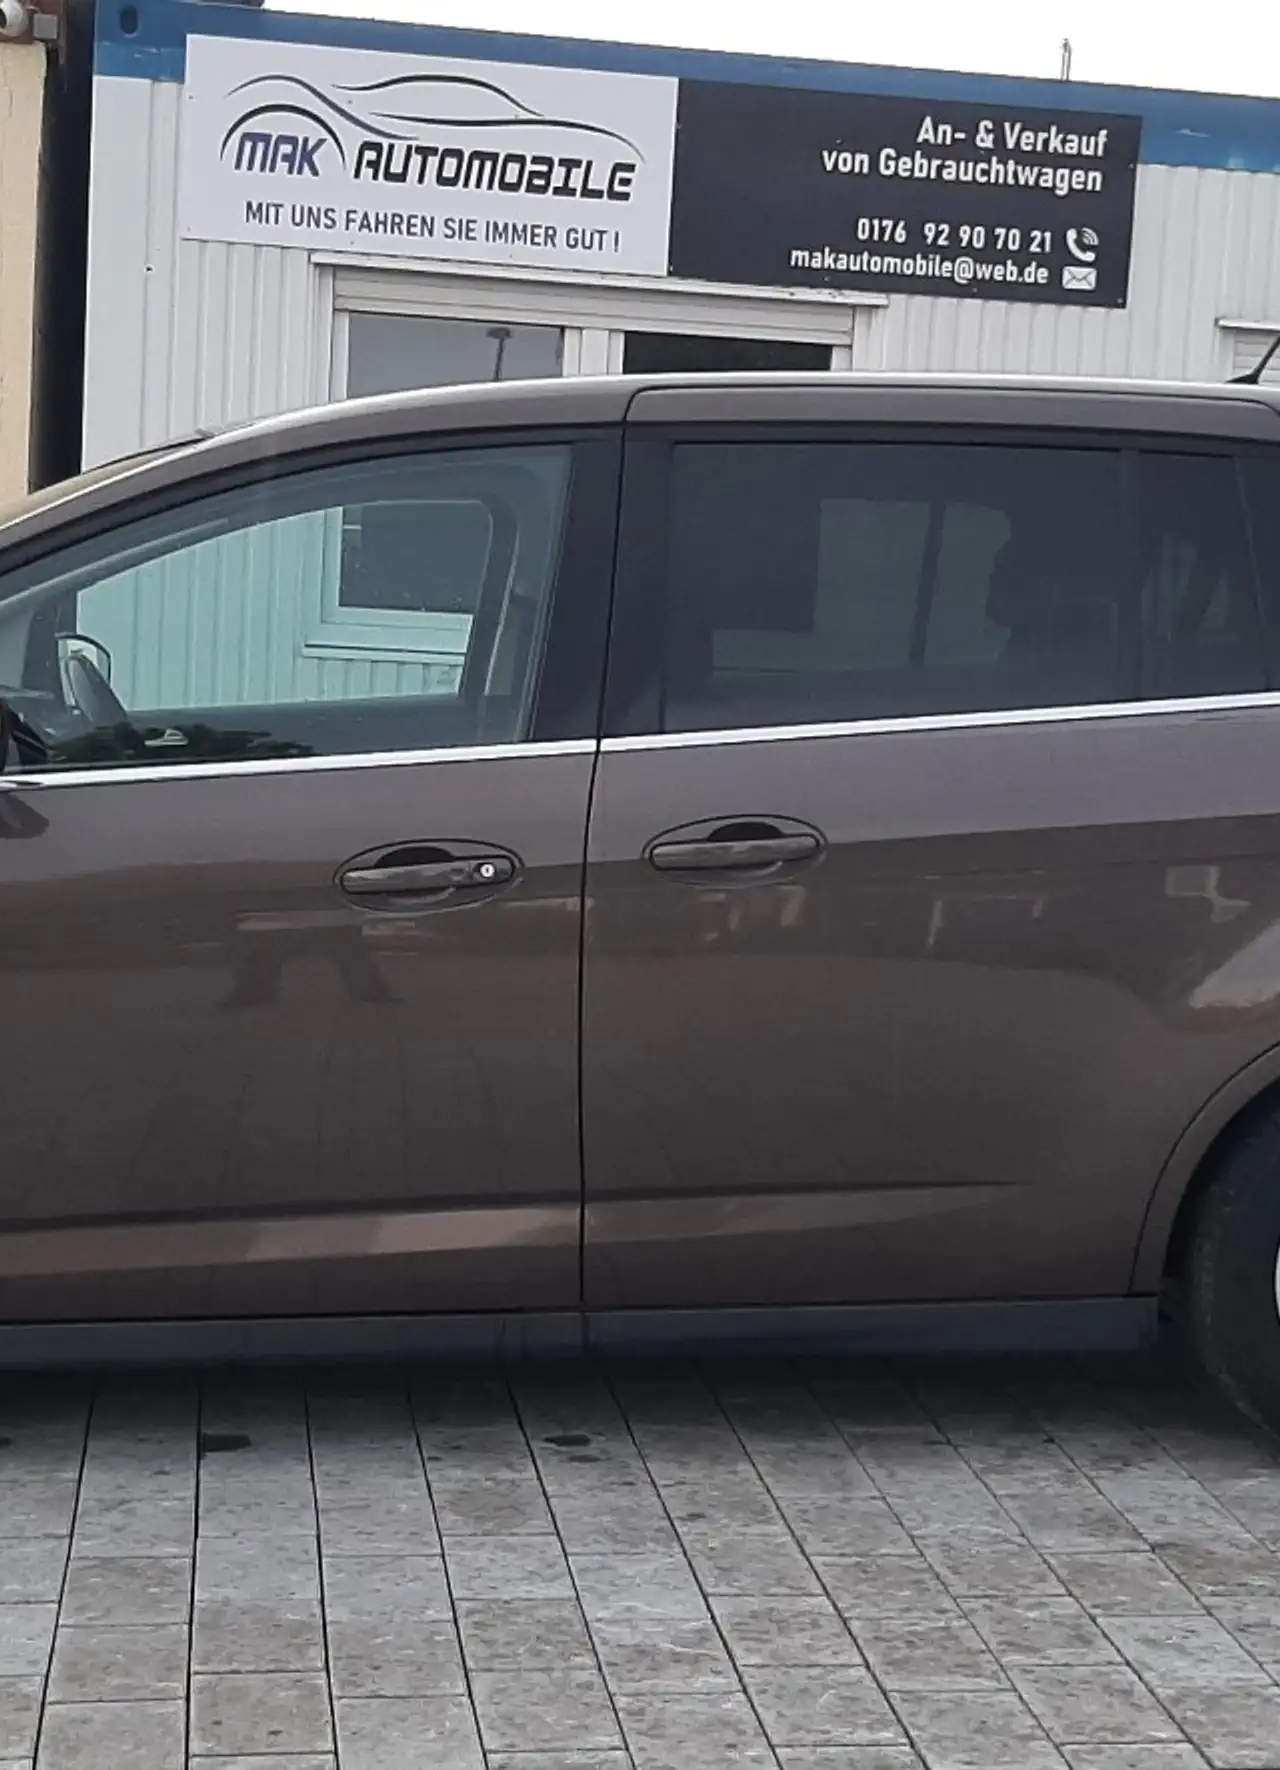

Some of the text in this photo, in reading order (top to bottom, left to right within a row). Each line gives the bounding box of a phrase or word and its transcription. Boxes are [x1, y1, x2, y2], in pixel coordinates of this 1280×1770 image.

[916, 116, 1109, 158] An- & Verkauf
[234, 132, 637, 202] MAK AUTOMOBILE
[822, 147, 1103, 197] von Gebrauchtwagen
[245, 200, 284, 226] MIT
[291, 203, 337, 230] UNS
[344, 209, 435, 238] FAHREN
[443, 217, 477, 241] SIE
[485, 219, 557, 249] IMMER
[565, 227, 608, 252] GUT
[856, 217, 1052, 253] 0176 92 90 70 21
[790, 246, 1049, 284] makautomobile@web.de
